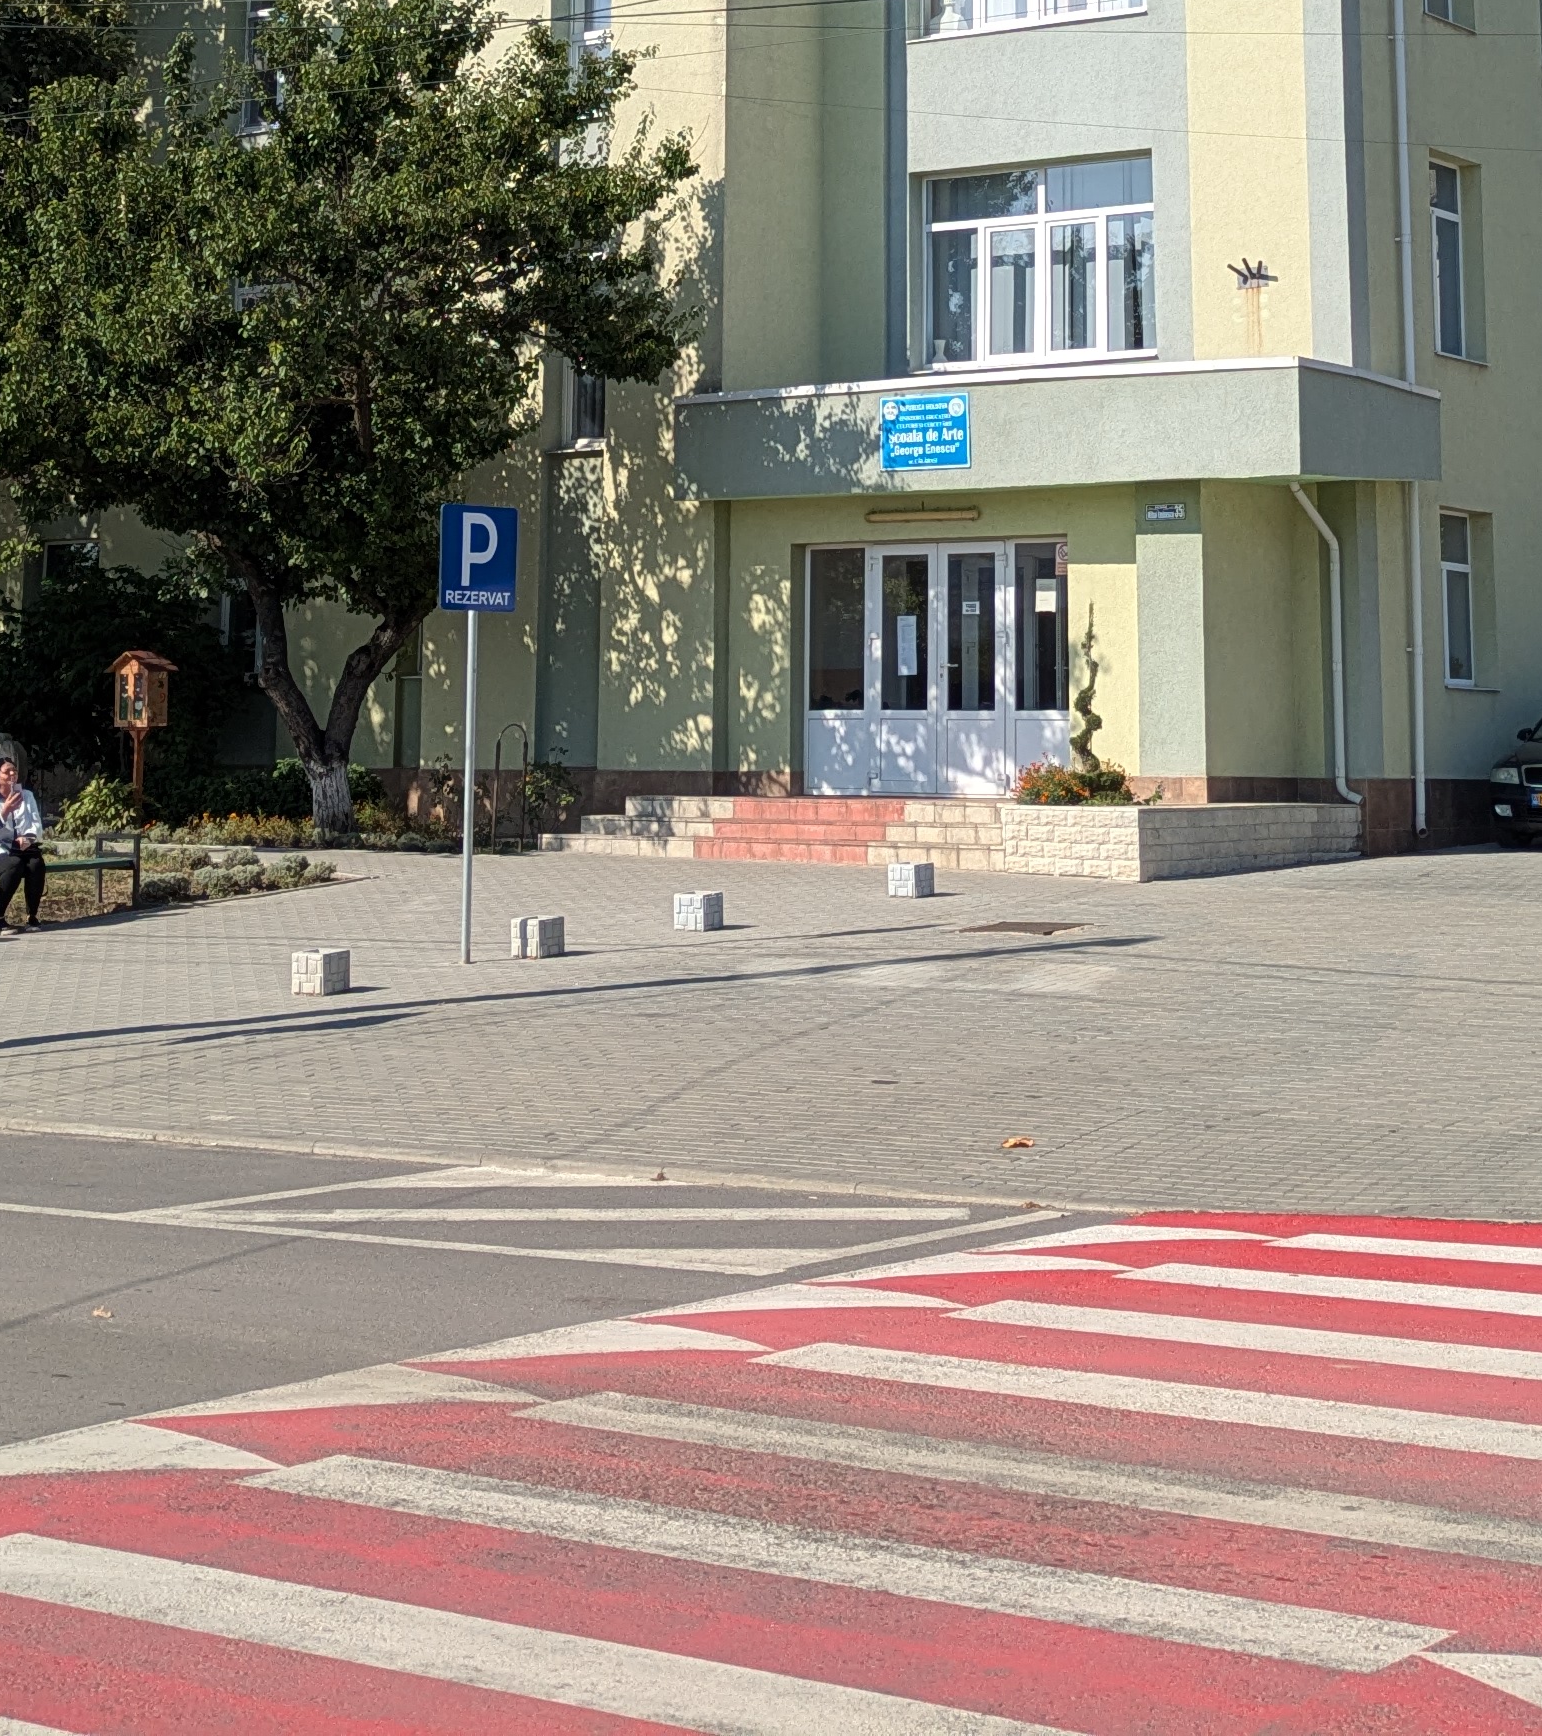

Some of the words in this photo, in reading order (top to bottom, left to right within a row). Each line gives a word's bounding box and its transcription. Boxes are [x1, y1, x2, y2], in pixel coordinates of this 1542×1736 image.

[926, 428, 939, 442] de
[941, 427, 964, 442] Arte
[461, 511, 498, 587] P
[445, 589, 511, 606] REZERVAT
